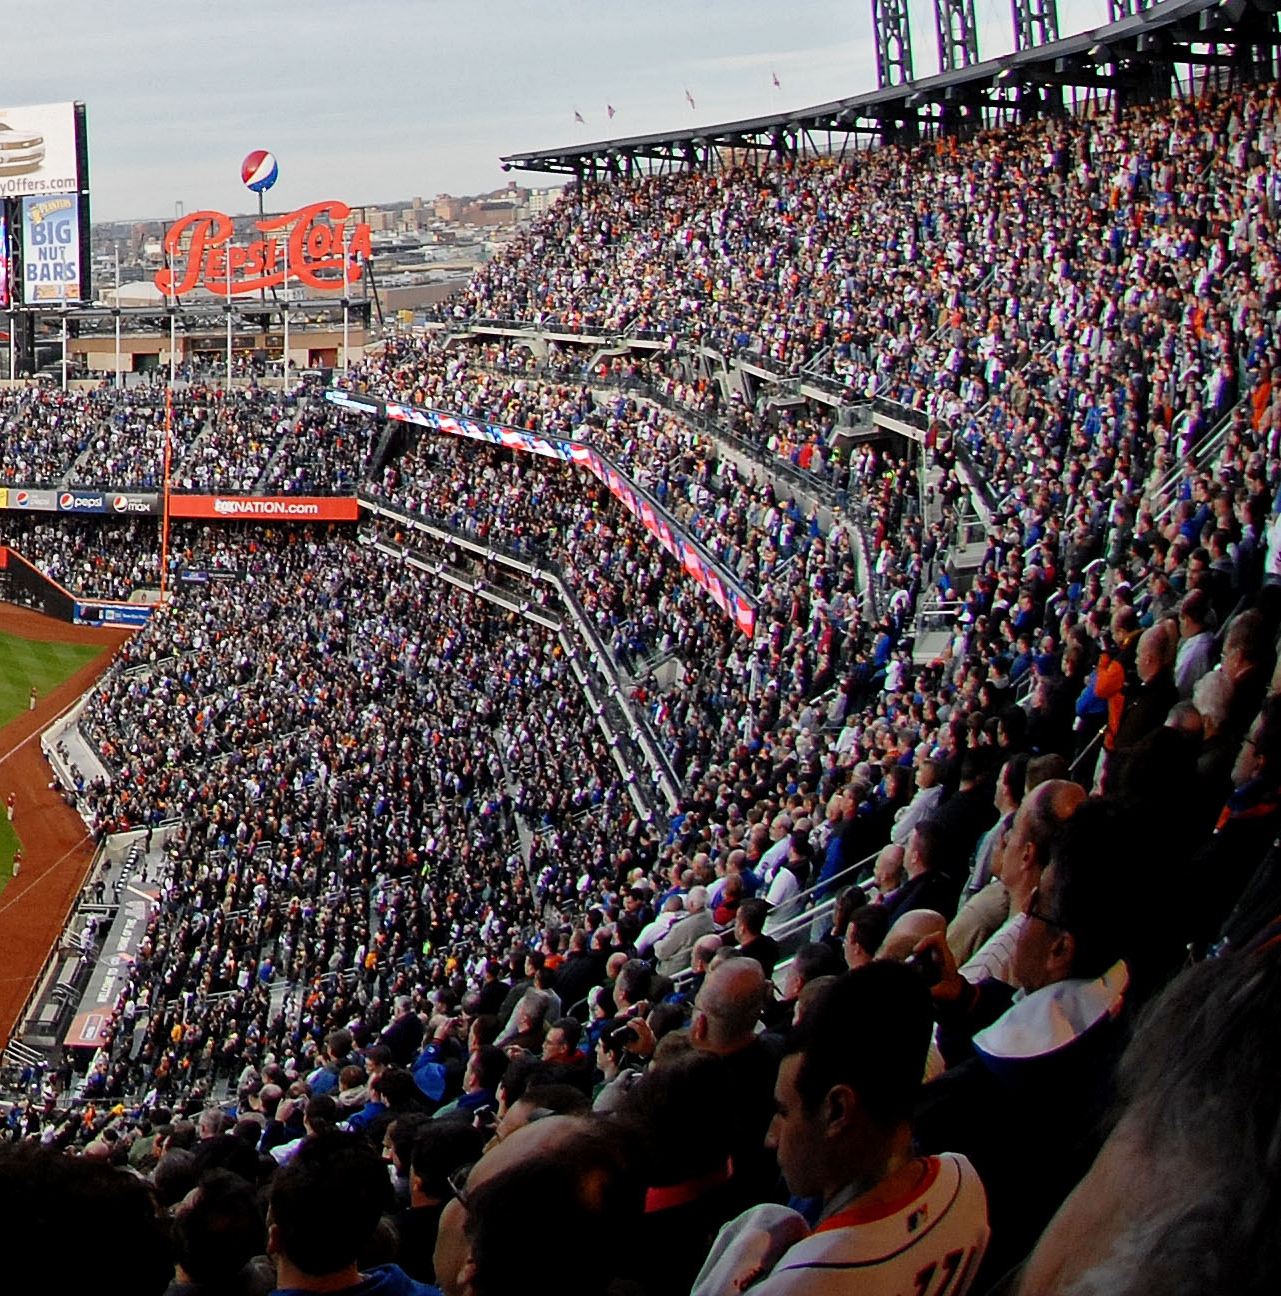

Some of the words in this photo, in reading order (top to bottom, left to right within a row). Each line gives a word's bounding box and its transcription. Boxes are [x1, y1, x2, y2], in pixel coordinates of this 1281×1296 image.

[31, 220, 71, 245] BIG
[38, 246, 66, 261] NUT
[26, 262, 76, 282] BARS
[74, 497, 103, 508] pepsi
[127, 502, 150, 512] max
